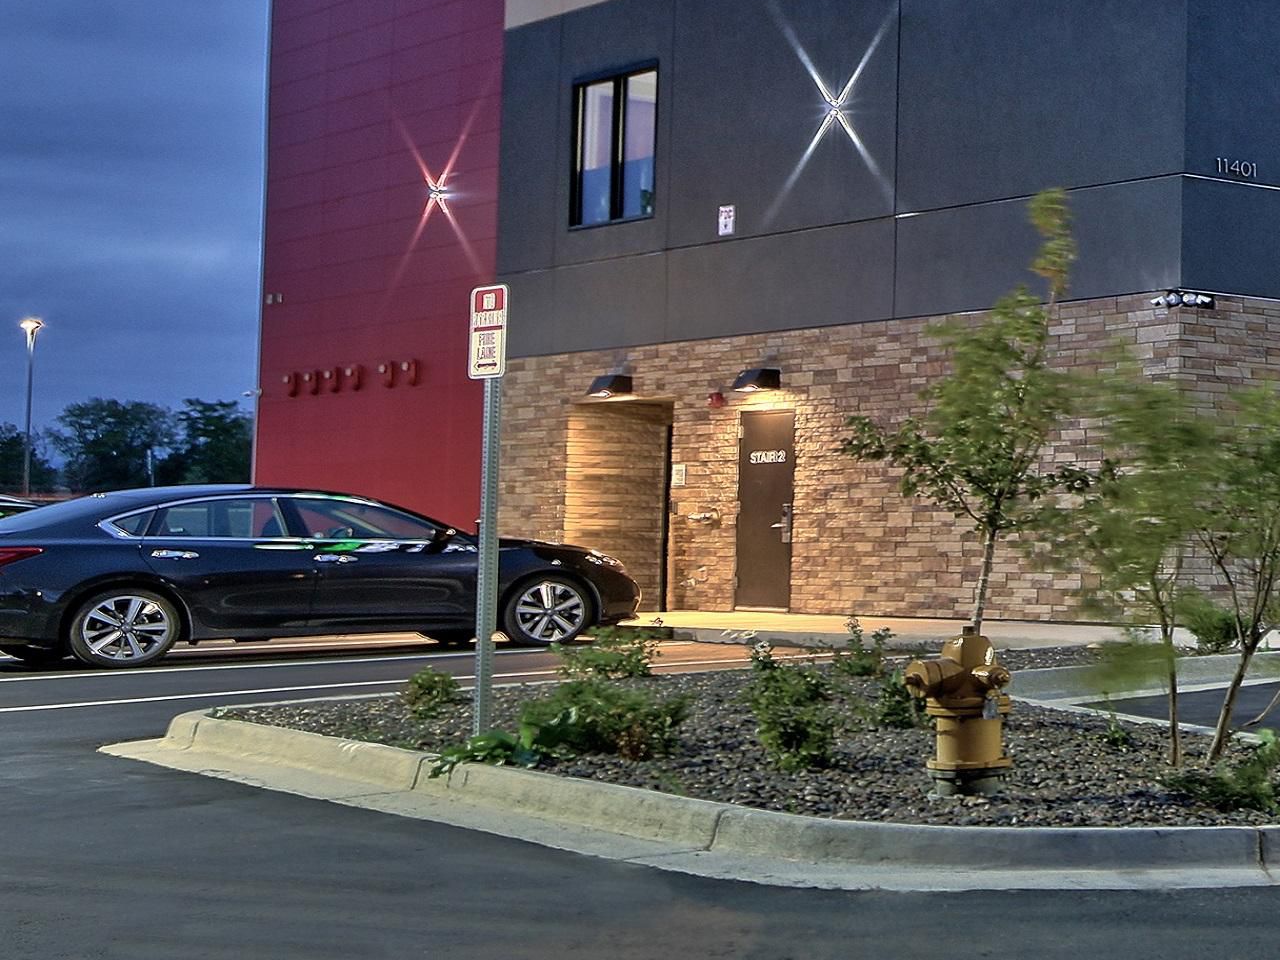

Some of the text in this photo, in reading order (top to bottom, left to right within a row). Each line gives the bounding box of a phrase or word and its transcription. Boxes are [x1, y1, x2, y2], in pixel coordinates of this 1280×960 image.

[1215, 157, 1258, 178] 11401
[750, 449, 786, 464] STAIR 2
